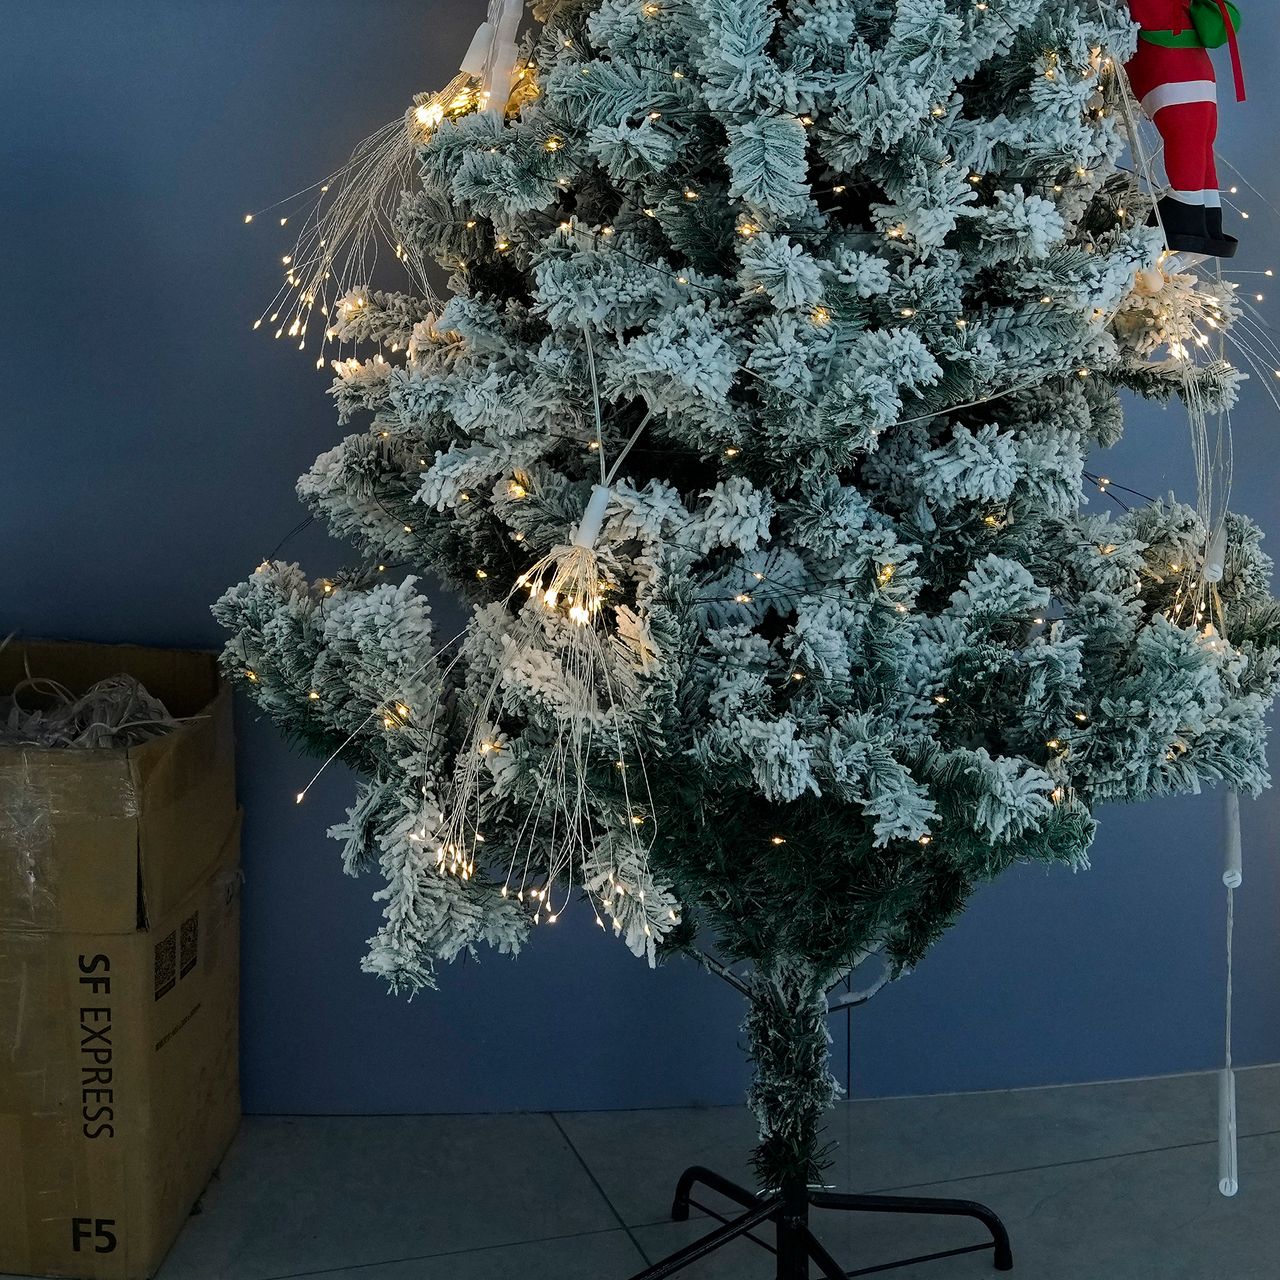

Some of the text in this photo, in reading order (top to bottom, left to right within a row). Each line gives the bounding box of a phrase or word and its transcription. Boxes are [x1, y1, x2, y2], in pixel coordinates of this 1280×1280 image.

[78, 954, 115, 1139] SF EXPRESS
[71, 1217, 117, 1254] F5
